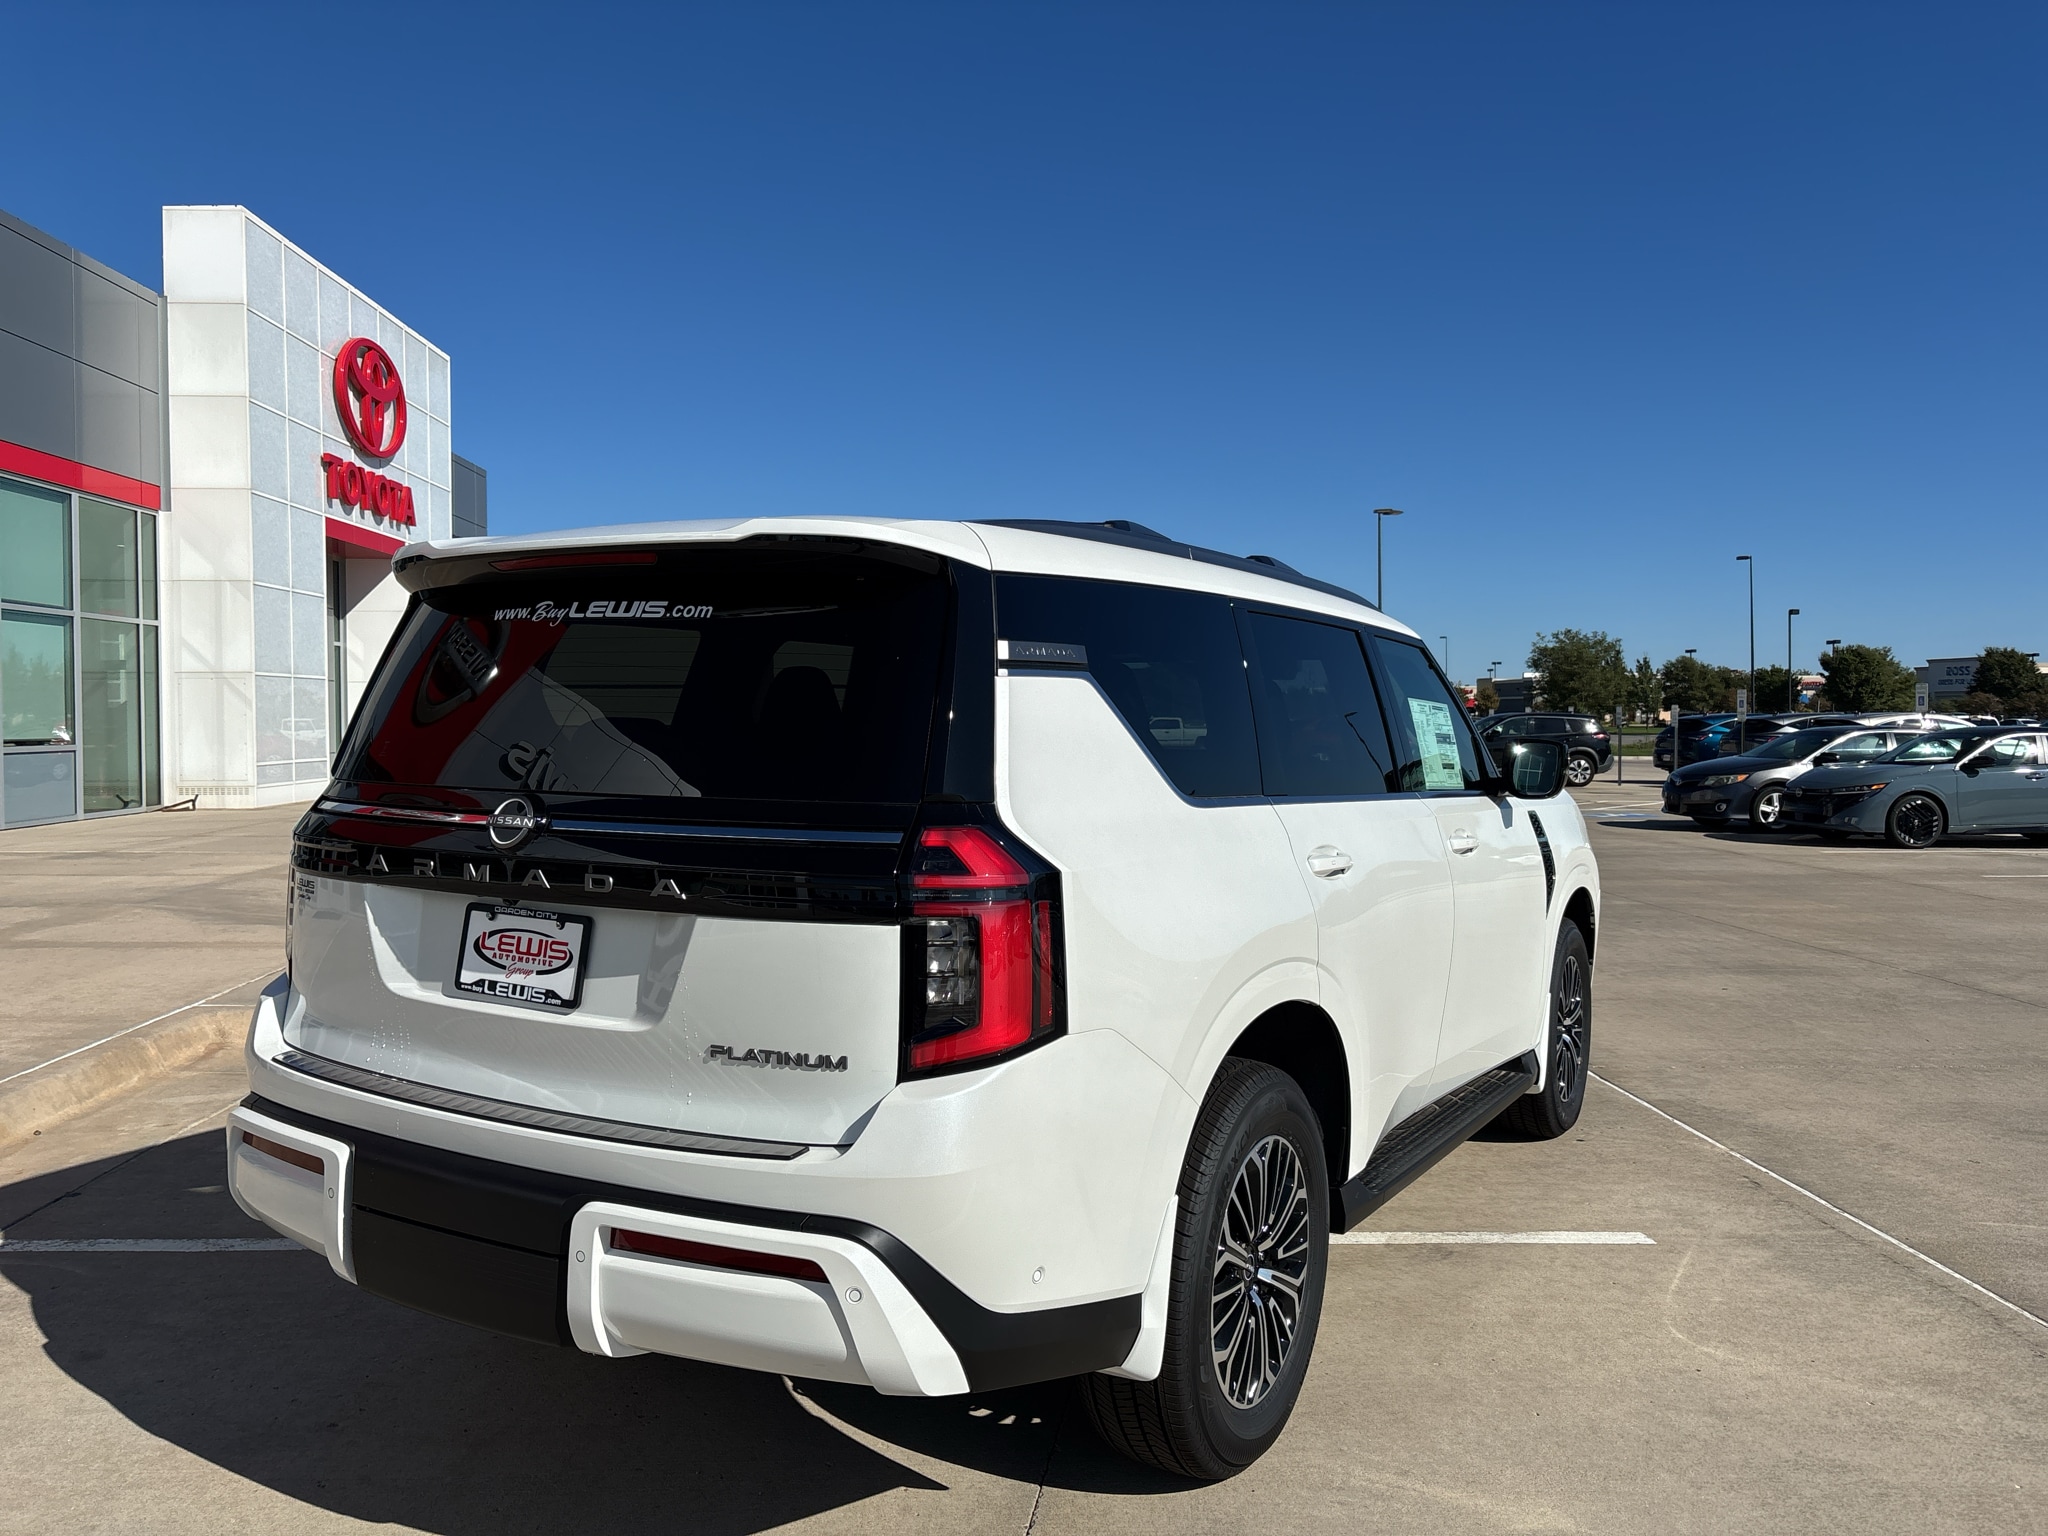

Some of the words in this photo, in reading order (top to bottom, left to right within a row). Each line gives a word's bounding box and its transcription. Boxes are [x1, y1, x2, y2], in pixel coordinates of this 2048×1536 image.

[322, 452, 417, 527] TOYOTA
[494, 600, 713, 627] www.BuyLEWIS.com
[1946, 665, 1971, 676] ROSS
[488, 816, 533, 828] NISSAN
[365, 853, 687, 900] ARMADA
[494, 906, 535, 917] GARDEN
[535, 911, 558, 920] CITY
[479, 931, 569, 962] LEWIS
[491, 952, 554, 967] AUTOMOTIVE
[504, 962, 535, 979] Group
[460, 979, 562, 1006] www.buyLEWIS.com
[709, 1044, 848, 1070] PLATINUM
